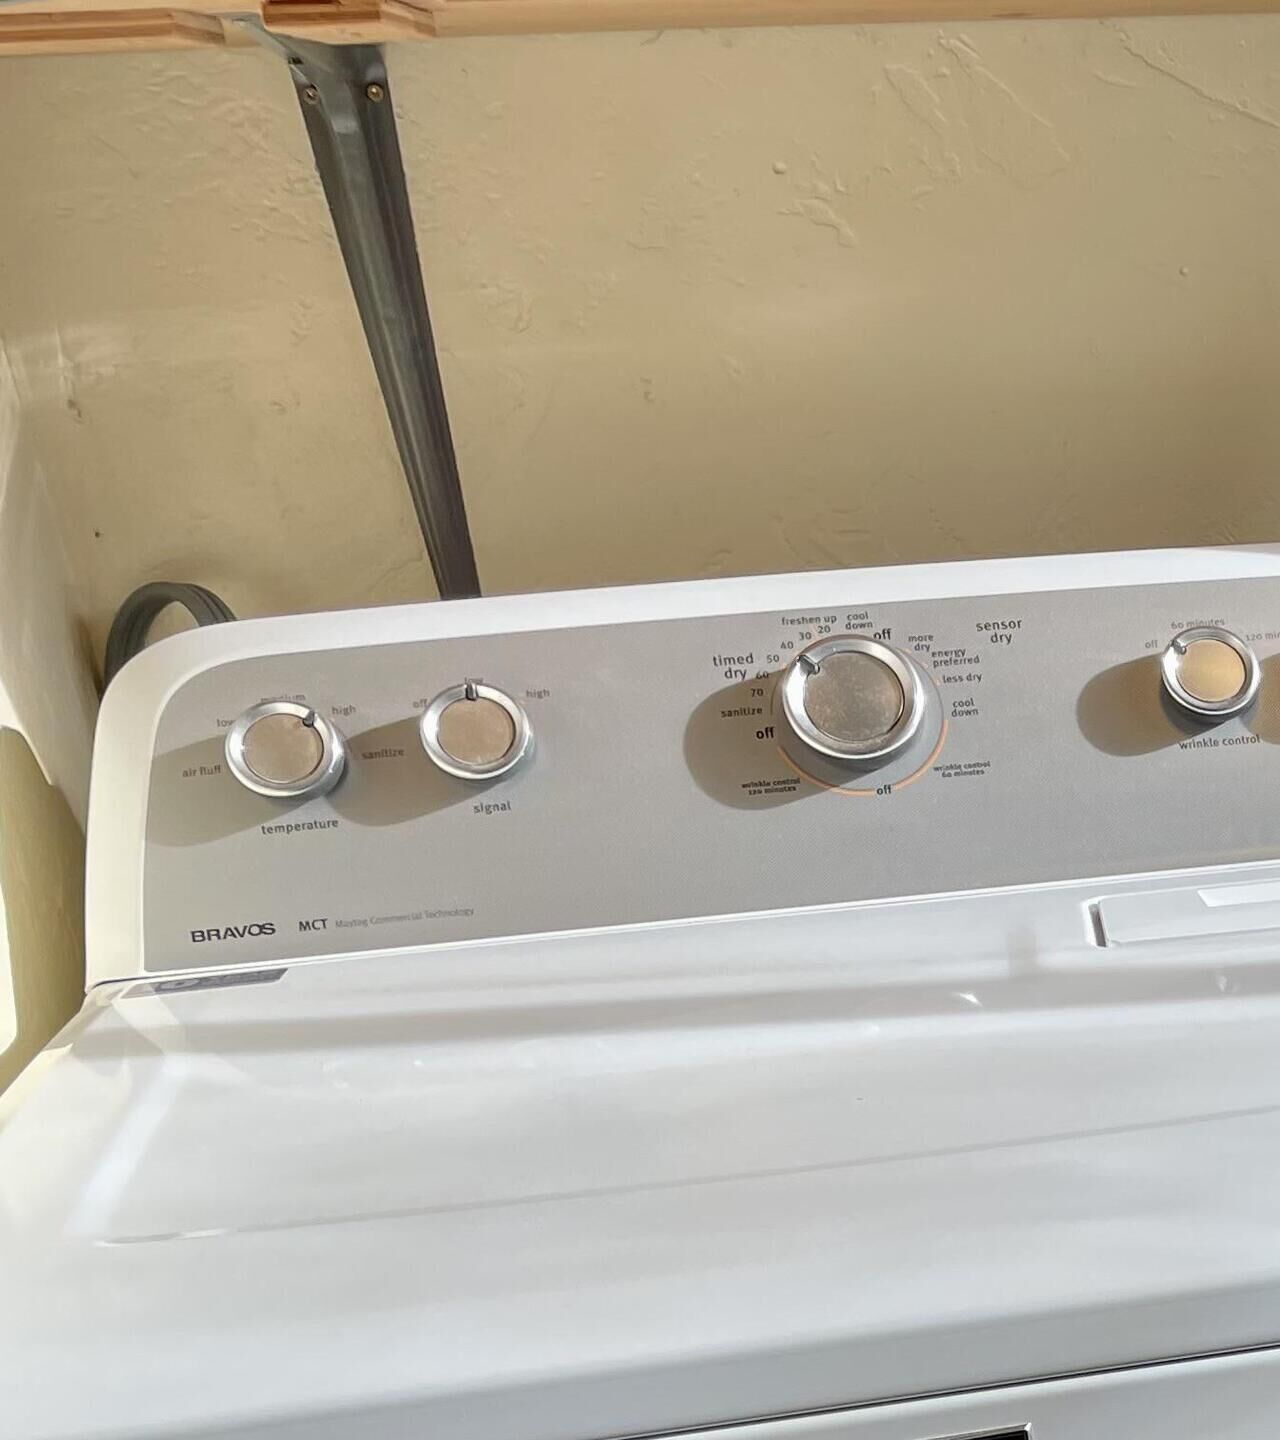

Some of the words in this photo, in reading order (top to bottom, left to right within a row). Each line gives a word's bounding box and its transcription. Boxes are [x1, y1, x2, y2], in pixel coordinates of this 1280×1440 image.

[782, 616, 821, 626] freshen
[824, 615, 837, 625] up
[847, 611, 869, 621] cool
[818, 625, 831, 634] 20
[845, 621, 873, 631] down
[976, 619, 1023, 632] sensor
[873, 629, 892, 641] off
[908, 634, 934, 642] more
[990, 632, 1013, 645] dry
[914, 642, 931, 653] dry
[931, 648, 966, 658] energy
[713, 653, 754, 667] timed
[767, 655, 780, 664] 50
[933, 655, 980, 668] preferred
[724, 667, 747, 681] dry
[942, 674, 964, 684] less
[966, 672, 983, 684] dry
[526, 688, 550, 699] high
[750, 688, 764, 697] 70
[952, 698, 975, 708] cool
[332, 704, 357, 716] high
[721, 706, 763, 718] sanitize
[951, 707, 979, 718] down
[756, 727, 775, 740] off
[1179, 737, 1220, 750] wrinkle
[1222, 734, 1261, 745] control
[362, 749, 405, 760] sanitize
[182, 767, 197, 778] air
[877, 784, 892, 796] off
[473, 801, 512, 815] signal
[261, 818, 339, 835] temperature
[190, 922, 276, 943] BRAVOS
[298, 918, 328, 932] MCT
